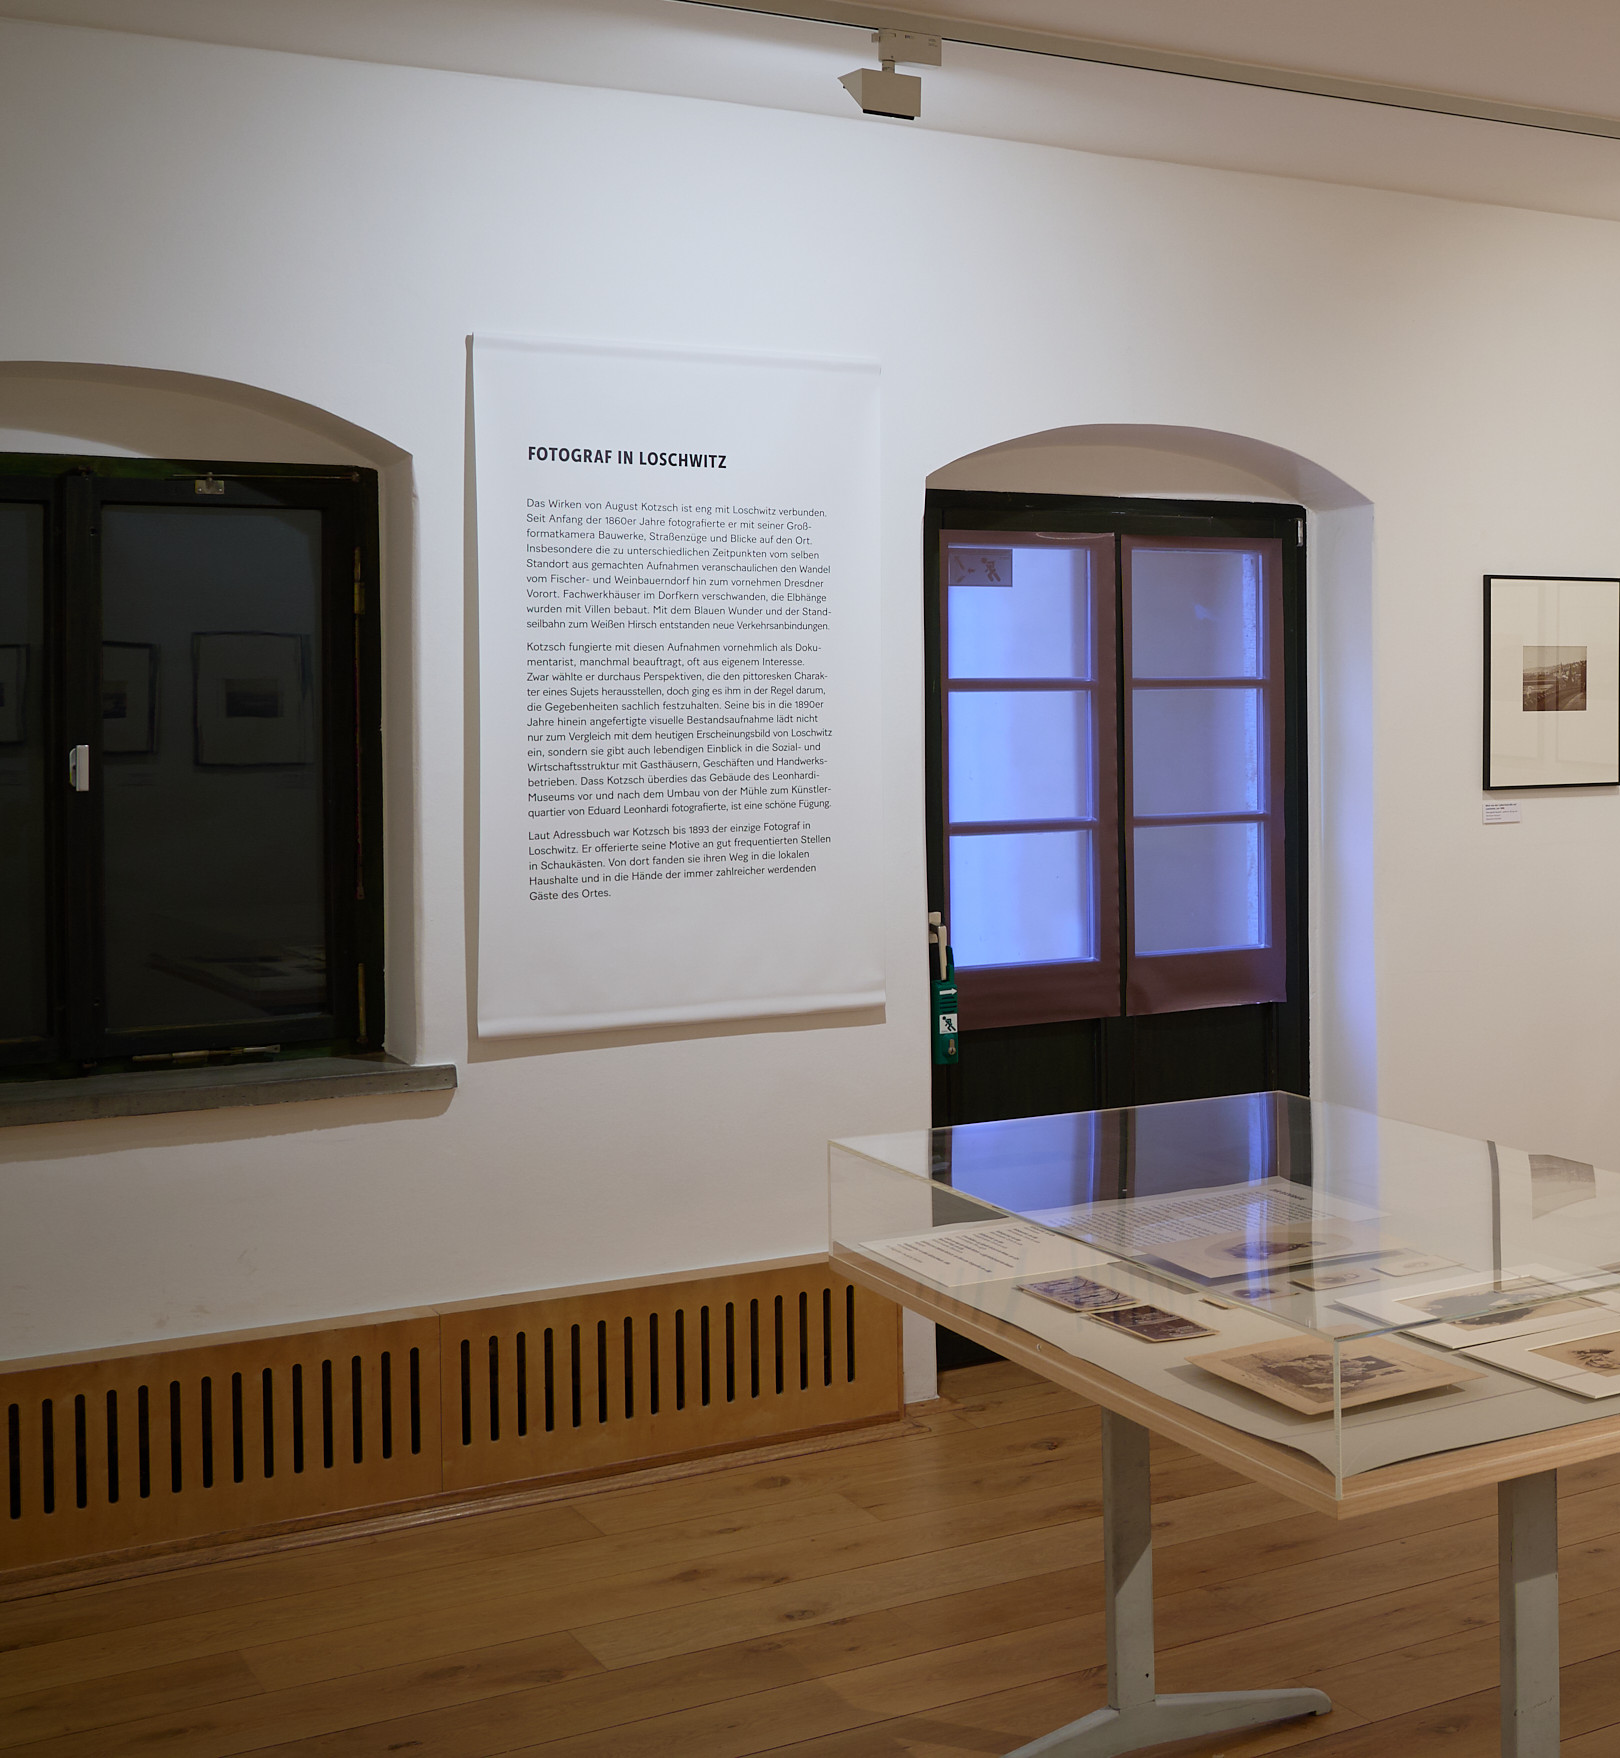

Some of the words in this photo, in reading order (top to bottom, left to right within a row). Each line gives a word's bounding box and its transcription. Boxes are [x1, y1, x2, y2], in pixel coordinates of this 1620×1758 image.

[528, 446, 613, 463] FOTOGRAF
[617, 451, 634, 464] IN
[639, 452, 727, 468] LOSCHWITZ
[526, 498, 546, 507] Das
[547, 499, 582, 509] Wirken
[604, 501, 639, 512] August
[640, 502, 679, 512] Kotzsch
[681, 504, 693, 512] ist
[694, 506, 713, 515] eng
[714, 505, 731, 514] mit
[732, 506, 777, 515] Loschwitz
[778, 508, 828, 517] verbunden.
[525, 513, 547, 523] Seit
[548, 514, 584, 526] Anfang
[585, 515, 603, 524] der
[604, 517, 638, 525] 1860er
[638, 517, 666, 526] Jahre
[667, 518, 726, 529] fotografierte
[739, 520, 756, 529] mit
[757, 521, 785, 529] seiner
[786, 522, 813, 530] Groß-
[526, 544, 593, 554] Insbesondere
[595, 545, 611, 554] die
[626, 547, 710, 556] unterschiedlichen
[712, 548, 768, 559] Zeitpunkten
[790, 550, 820, 559] selben
[550, 574, 590, 583] Fischer-
[592, 575, 612, 584] und
[613, 576, 691, 585] Weinbauerndorf
[692, 577, 707, 585] hin
[730, 578, 782, 587] vornehmen
[784, 579, 825, 587] Dresdner
[526, 619, 566, 628] seilbahn
[590, 620, 626, 628] Weißen
[627, 620, 658, 629] Hirsch
[658, 620, 711, 629] entstanden
[736, 621, 831, 632] Verkehrsanbindungen.
[526, 642, 566, 651] Kotzsch
[568, 642, 613, 655] fungierte
[614, 643, 631, 651] mit
[632, 643, 665, 651] diesen
[666, 643, 721, 651] Aufnahmen
[722, 643, 779, 651] vornehmlich
[779, 643, 793, 651] als
[795, 643, 822, 651] Doku-
[526, 688, 541, 696] ter
[542, 687, 569, 696] eines
[569, 687, 600, 698] Sujets
[601, 687, 665, 696] herausstellen,
[666, 687, 690, 695] doch
[691, 687, 711, 697] ging
[724, 686, 742, 695] ihm
[743, 686, 752, 694] in
[753, 686, 769, 694] der
[770, 686, 794, 696] Regel
[795, 686, 826, 695] darum,
[526, 702, 543, 711] die
[544, 702, 619, 713] Gegebenheiten
[621, 701, 660, 710] sachlich
[662, 701, 722, 710] festzuhalten.
[723, 701, 750, 709] Seine
[752, 700, 766, 709] bis
[767, 700, 777, 709] in
[778, 700, 793, 708] die
[526, 717, 555, 726] Jahre
[557, 717, 587, 726] hinein
[589, 716, 648, 727] angefertigte
[648, 716, 685, 725] visuelle
[686, 715, 775, 724] Bestandsaufnahme
[776, 714, 794, 723] lädt
[795, 714, 819, 722] nicht
[527, 748, 546, 757] ein,
[547, 747, 589, 756] sondern
[590, 747, 605, 755] sie
[606, 746, 626, 757] gibt
[627, 746, 652, 754] auch
[653, 745, 705, 755] lebendigen
[706, 744, 743, 753] Einblick
[744, 744, 754, 752] in
[755, 743, 771, 752] die
[771, 743, 802, 751] Sozial-
[803, 742, 822, 751] und
[526, 761, 621, 772] Wirtschaftsstruktur
[622, 761, 639, 769] mit
[639, 760, 701, 769] Gasthäusern,
[702, 758, 755, 767] Geschäften
[756, 757, 775, 766] und
[776, 756, 829, 765] Handwerks-
[527, 793, 576, 802] Museums
[595, 790, 615, 800] und
[617, 790, 641, 799] nach
[642, 790, 665, 798] dem
[666, 789, 701, 798] Umbau
[721, 787, 738, 796] der
[739, 786, 768, 795] Mühle
[791, 785, 832, 794] Künstler-
[528, 832, 551, 840] Laut
[552, 828, 611, 839] Adressbuch
[632, 826, 671, 836] Kotzsch
[672, 826, 687, 834] bis
[688, 826, 710, 834] 1893
[711, 824, 728, 833] der
[729, 823, 762, 834] einzige
[763, 821, 801, 832] Fotograf
[802, 821, 811, 829] in
[528, 845, 579, 855] Loschwitz.
[581, 844, 593, 853] Er
[594, 843, 640, 852] offerierte
[641, 842, 667, 850] seine
[669, 840, 701, 849] Motive
[716, 840, 732, 849] gut
[733, 837, 799, 851] frequentierten
[800, 835, 832, 844] Stellen
[528, 862, 538, 870] in
[540, 860, 606, 870] Schaukästen.
[607, 858, 627, 867] Von
[629, 857, 650, 866] dort
[652, 855, 686, 864] fanden
[687, 854, 701, 863] sie
[703, 854, 727, 862] ihren
[728, 853, 749, 863] Weg
[750, 852, 760, 860] in
[761, 851, 776, 860] die
[778, 850, 810, 859] lokalen
[528, 875, 579, 886] Haushalte
[581, 873, 600, 883] und
[602, 873, 612, 882] in
[613, 872, 630, 881] die
[631, 871, 663, 880] Hände
[664, 870, 682, 879] der
[683, 869, 714, 878] immer
[715, 866, 766, 876] zahlreicher
[766, 864, 817, 874] werdenden
[528, 891, 559, 901] Gäste
[560, 890, 580, 899] des
[581, 889, 612, 898] Ortes.
